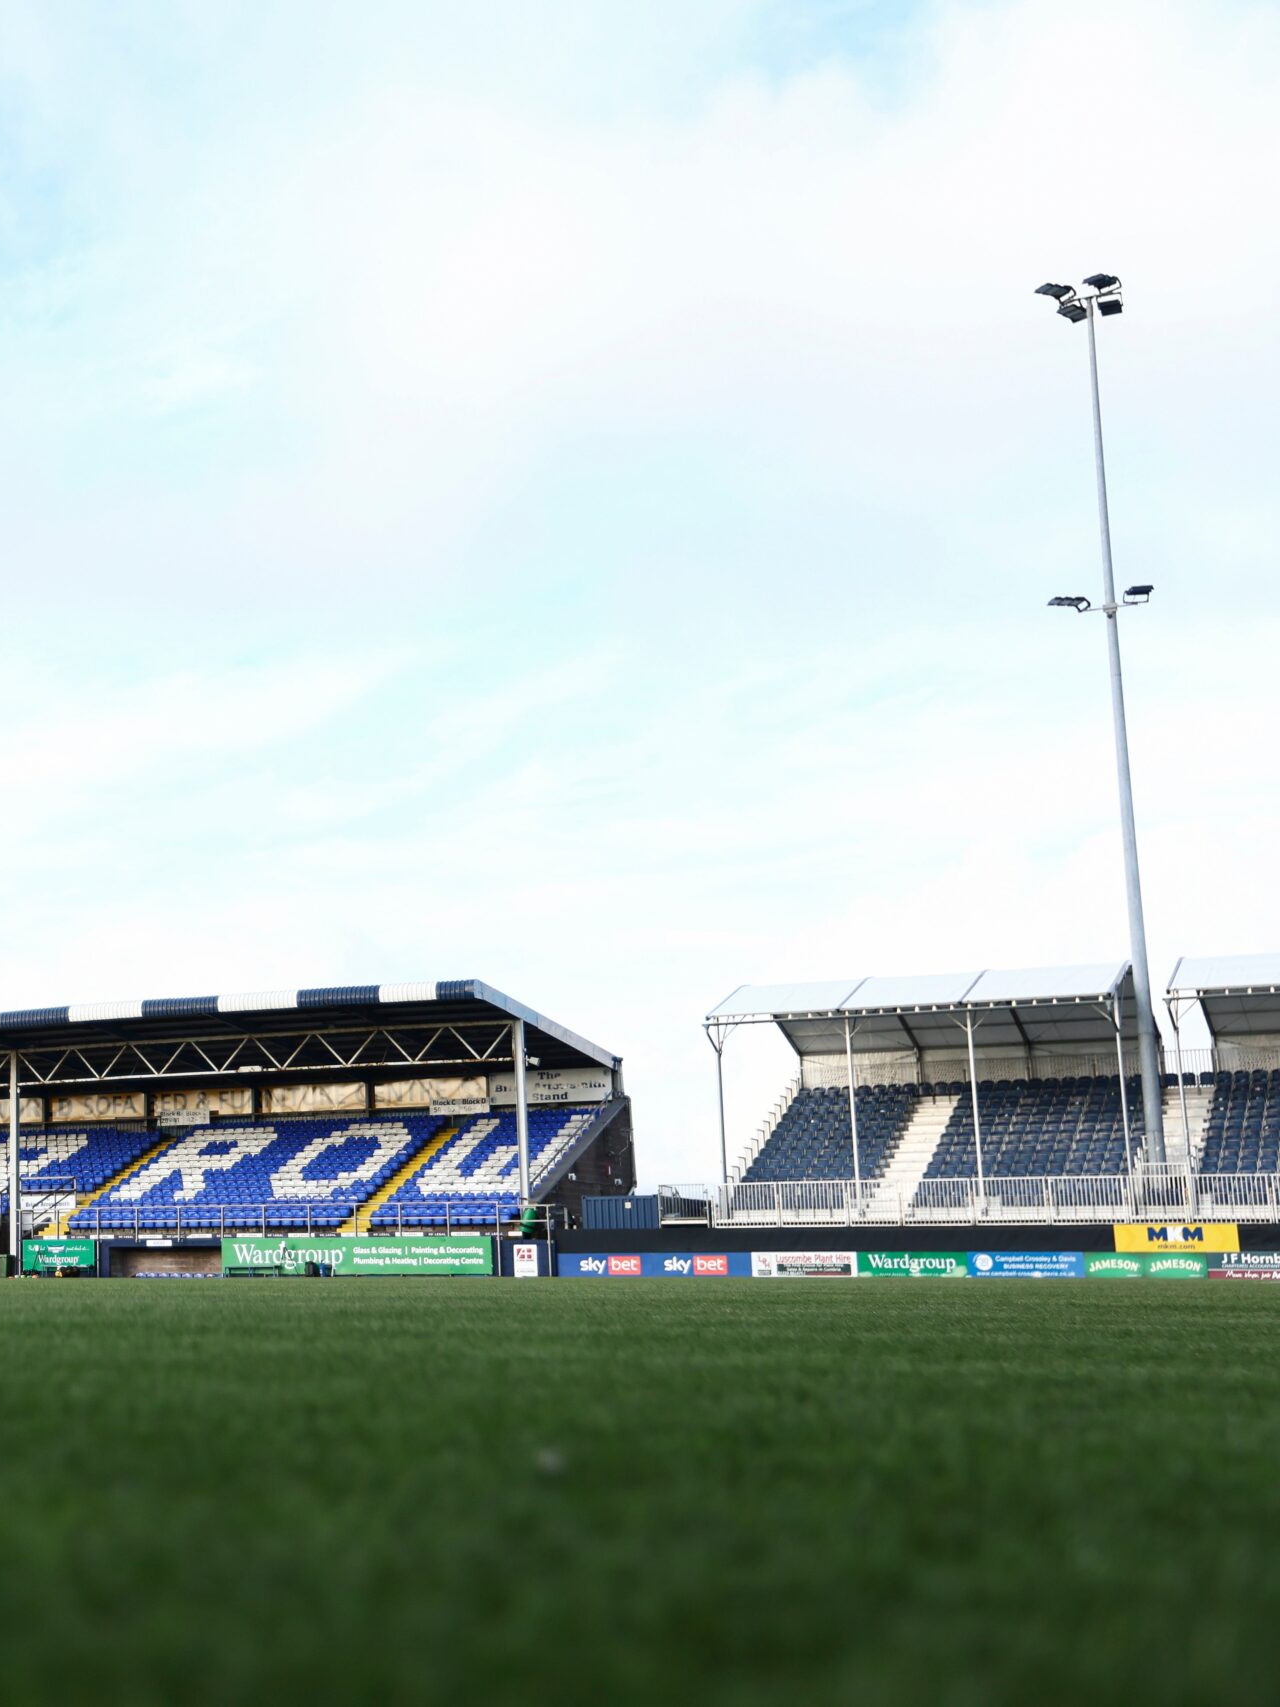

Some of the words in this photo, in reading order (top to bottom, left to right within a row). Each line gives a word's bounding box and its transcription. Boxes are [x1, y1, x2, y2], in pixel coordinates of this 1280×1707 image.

[537, 1072, 561, 1080] The
[533, 1092, 569, 1101] Stand
[84, 1094, 138, 1115] SOFA
[1147, 1227, 1204, 1241] MKM
[233, 1241, 343, 1269] Wardgroup
[353, 1246, 370, 1254] Glass
[371, 1246, 377, 1254] &
[378, 1246, 402, 1256] Glazing
[411, 1246, 438, 1255] Painting
[439, 1246, 445, 1254] &
[447, 1246, 483, 1255] Decorating
[38, 1254, 79, 1266] Wardgroup
[353, 1257, 383, 1265] Plumbing
[392, 1257, 417, 1265] Heating
[424, 1257, 459, 1265] Decorating
[580, 1256, 606, 1274] sky
[611, 1257, 638, 1271] bet
[664, 1256, 691, 1274] sky
[696, 1257, 724, 1271] bet
[776, 1254, 812, 1263] Luscombe
[815, 1254, 832, 1263] Plant
[836, 1254, 851, 1262] Hire
[868, 1254, 956, 1273] Wardgroup
[1221, 1253, 1228, 1264] J
[1230, 1253, 1238, 1264] F
[1089, 1259, 1138, 1272] JAMESON
[1150, 1259, 1201, 1272] JAMESON
